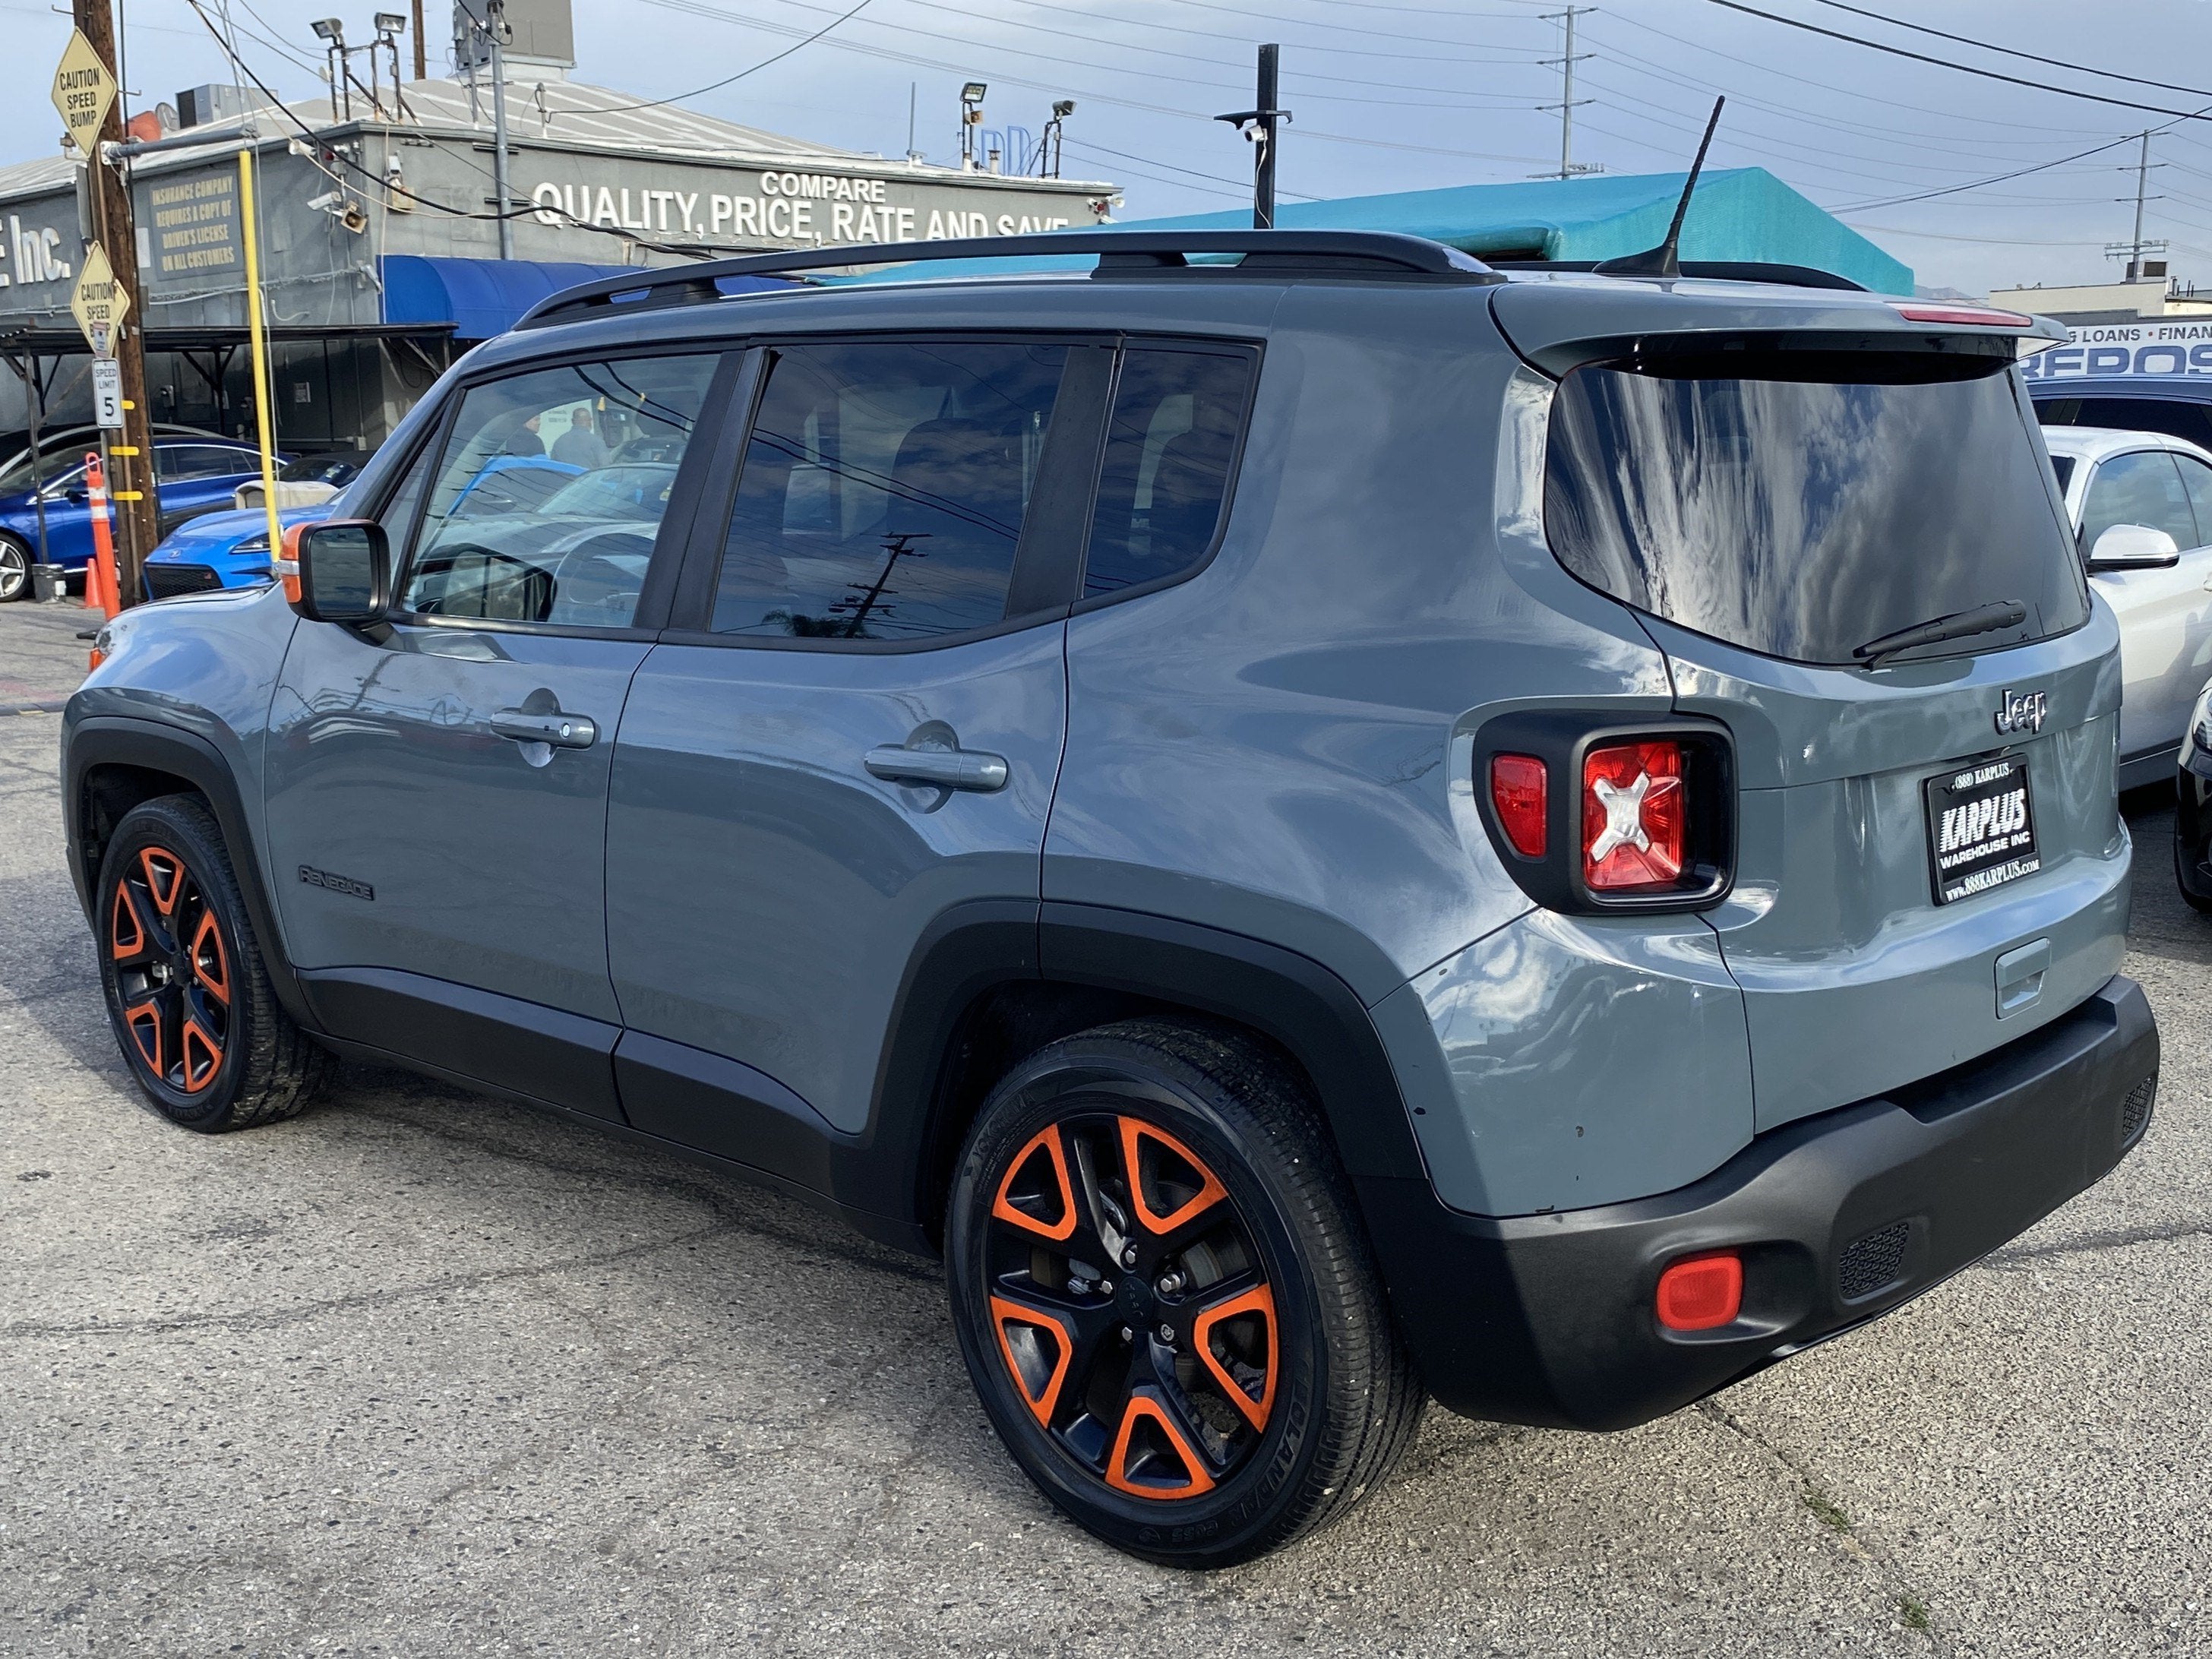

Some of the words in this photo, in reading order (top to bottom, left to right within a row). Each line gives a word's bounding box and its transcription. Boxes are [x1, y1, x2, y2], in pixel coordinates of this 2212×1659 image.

[60, 68, 100, 91] CAUTION
[67, 92, 96, 110] SPEED
[70, 110, 96, 128] BUMP
[153, 183, 194, 206] INSURANCE
[195, 175, 232, 198] COMPANY
[760, 171, 886, 204] COMPARE
[156, 206, 192, 228] REQUIRES
[192, 205, 199, 222] A
[199, 201, 220, 221] COPY
[221, 199, 232, 217] OF
[532, 182, 705, 240] QUALITY,
[710, 194, 823, 248] PRICE,
[831, 202, 915, 243] RATE
[925, 209, 988, 241] AND
[198, 223, 229, 244] LICENSE
[10, 215, 71, 284] Inc.
[162, 255, 175, 272] ON
[174, 253, 188, 270] ALL
[187, 246, 235, 269] CUSTOMERS
[81, 281, 115, 302] CAUTION
[87, 304, 110, 320] SPEED
[90, 322, 111, 338] BP
[2082, 328, 2141, 343] LOANS
[96, 368, 117, 378] SPEED
[99, 380, 115, 390] LIMIT
[104, 397, 115, 417] 5
[1996, 689, 2047, 735] Jeep
[1974, 762, 2010, 785] KARPLUS
[1939, 788, 2025, 853] KARPLUS
[1939, 836, 2008, 870] WAREHOUSE
[2011, 830, 2030, 847] INC
[299, 864, 374, 901] RENEGADE
